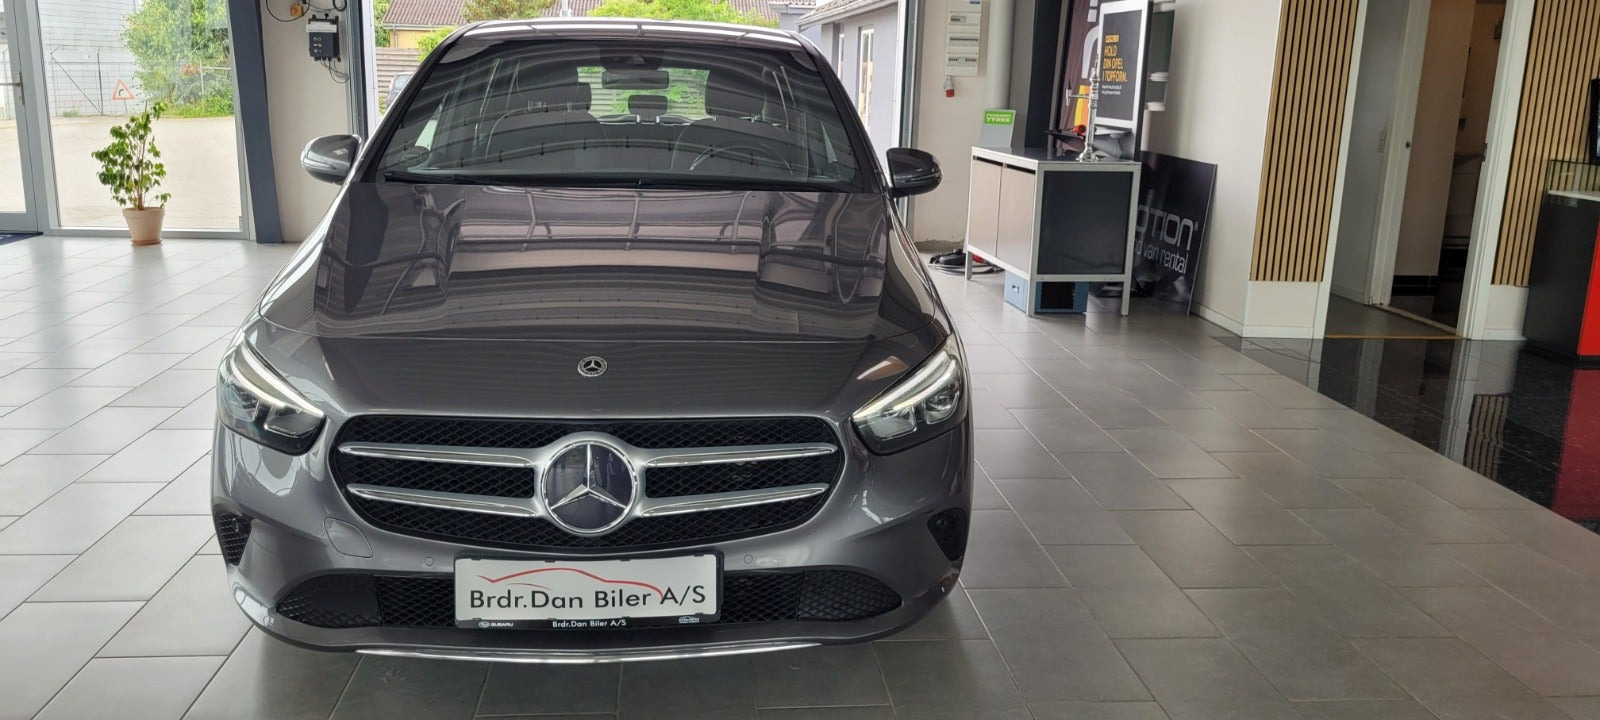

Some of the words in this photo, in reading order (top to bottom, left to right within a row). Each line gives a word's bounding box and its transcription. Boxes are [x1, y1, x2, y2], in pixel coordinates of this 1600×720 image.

[1104, 45, 1118, 57] HOLD
[1103, 58, 1112, 70] DIN
[1112, 58, 1123, 70] OPEL
[1160, 249, 1189, 275] rental
[470, 589, 583, 609] Brdr.Dan
[594, 588, 652, 609] Biler
[660, 585, 706, 606] A/S
[552, 620, 587, 628] Brdr.Dan
[589, 619, 608, 627] Biler
[610, 619, 627, 627] A/S
